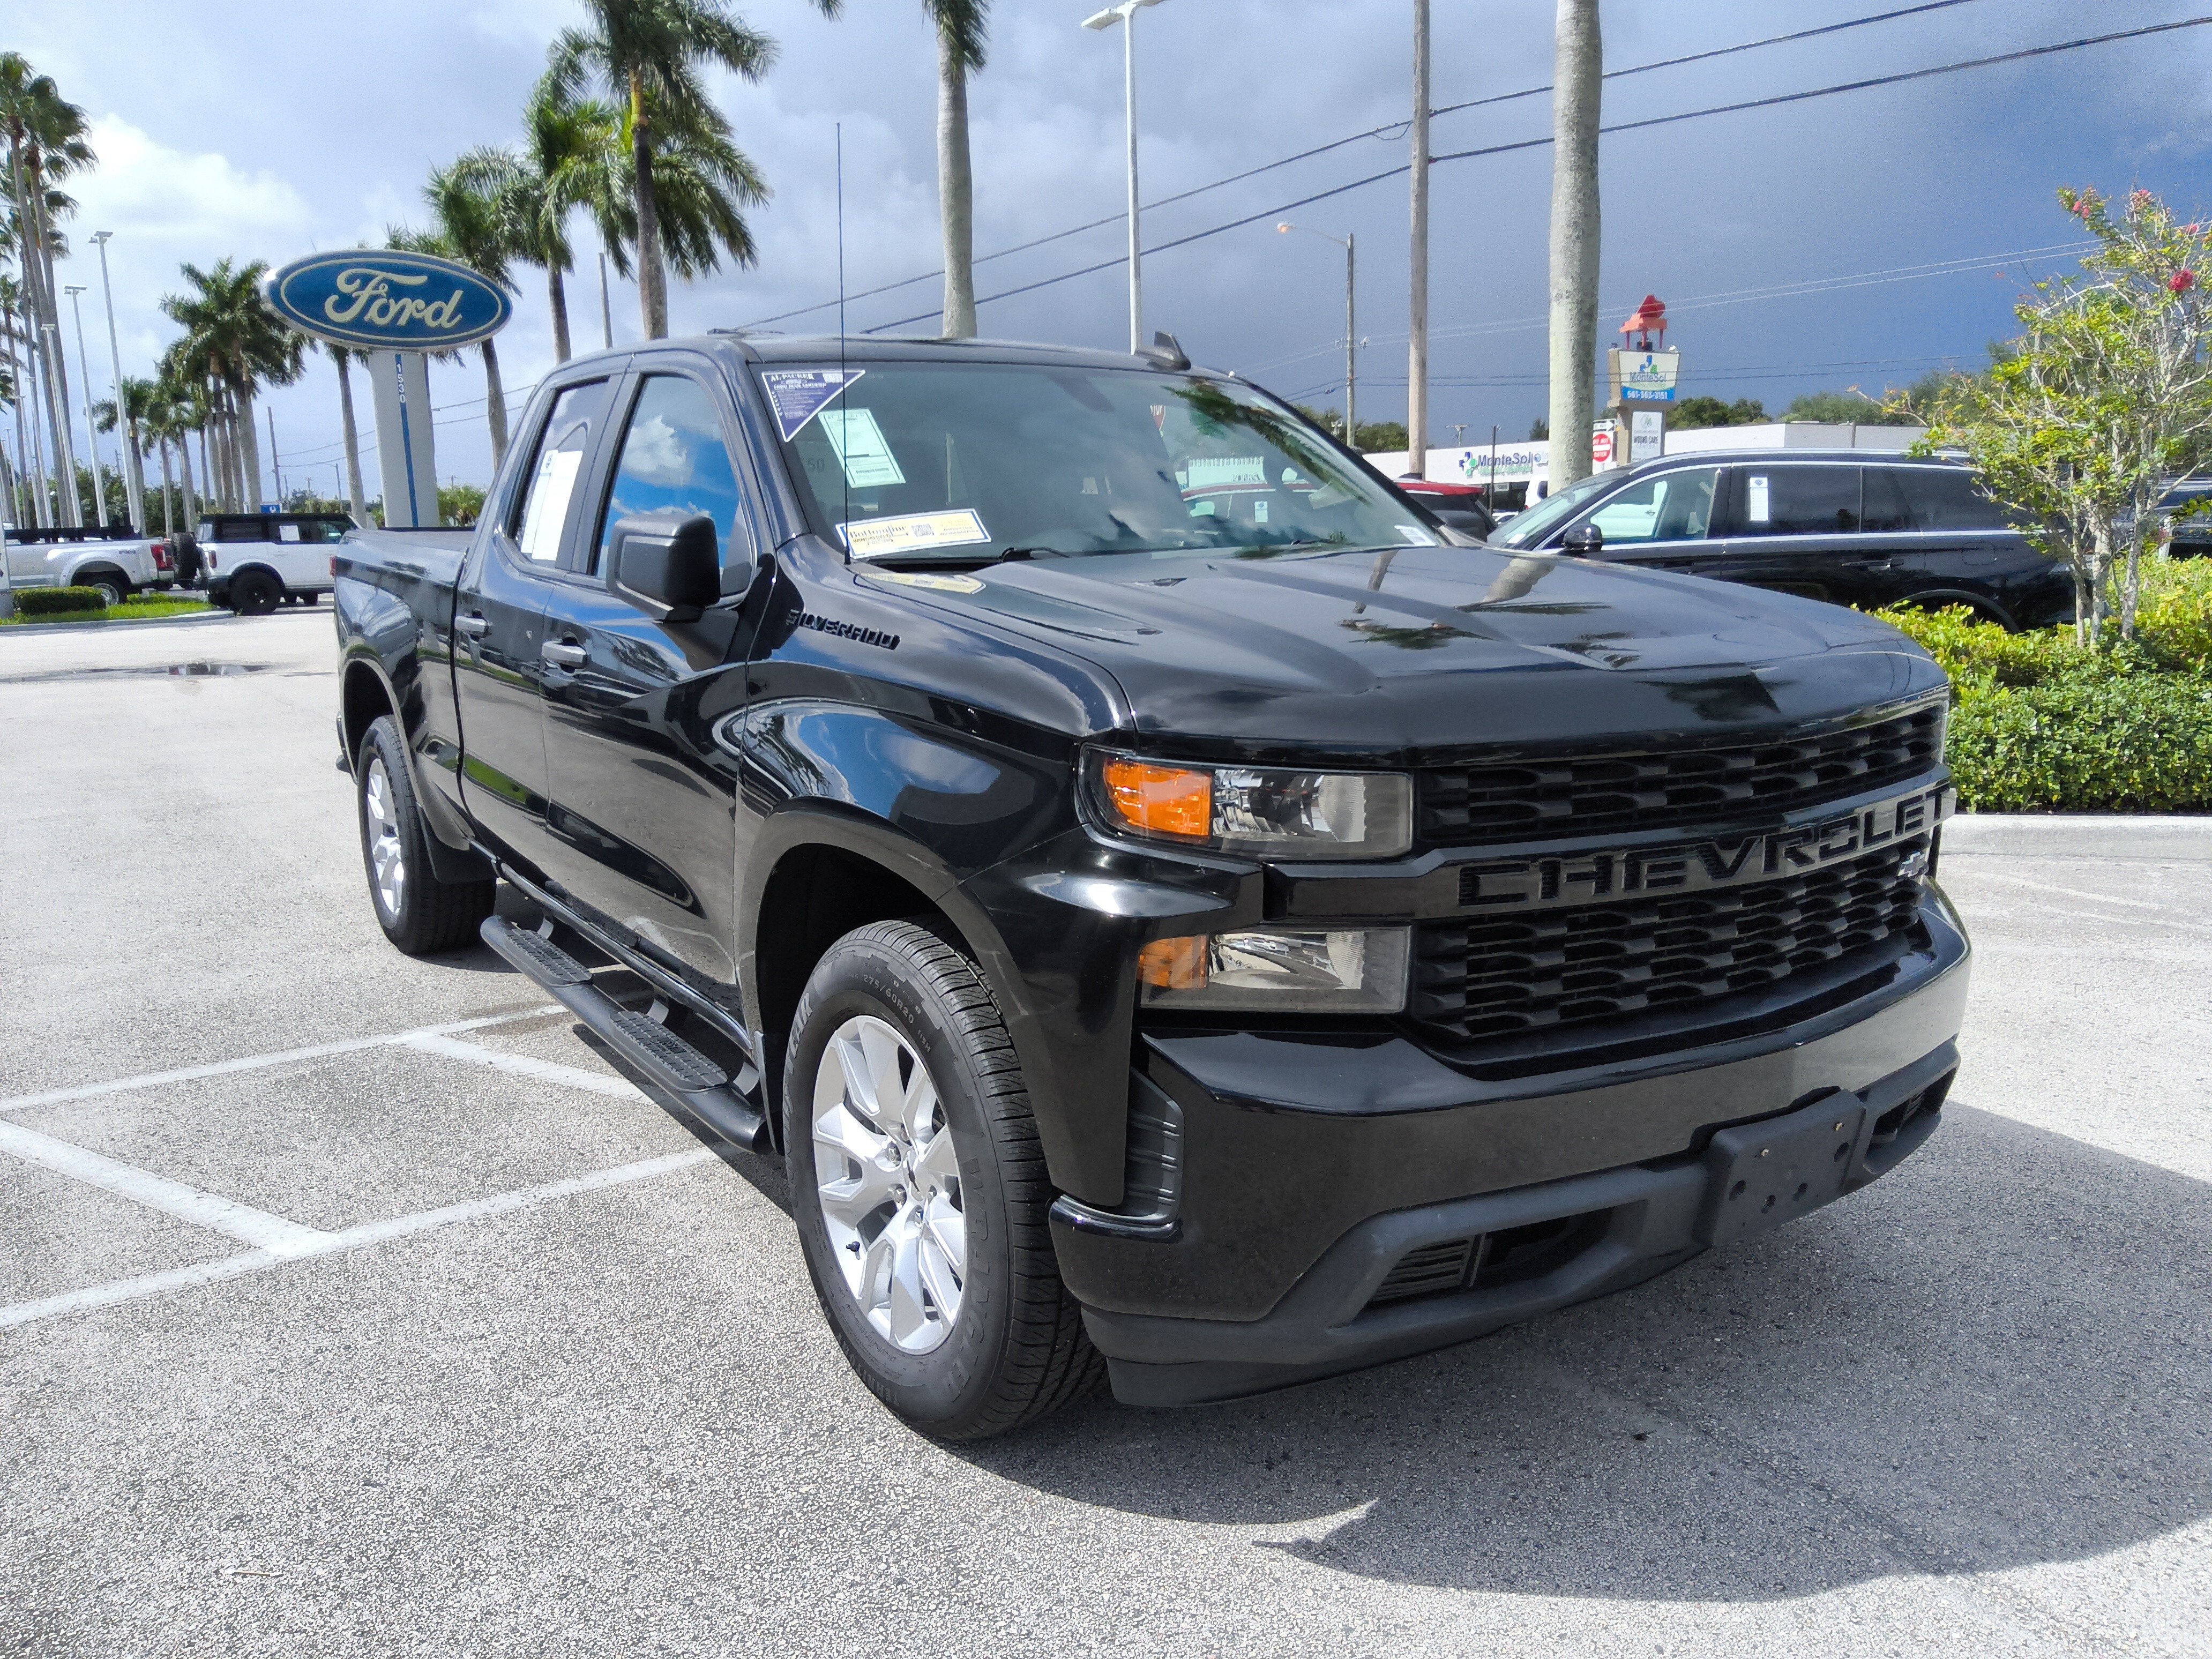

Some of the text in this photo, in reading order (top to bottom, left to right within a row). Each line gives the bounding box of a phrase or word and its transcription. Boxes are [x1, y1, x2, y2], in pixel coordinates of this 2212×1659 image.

[324, 268, 464, 328] Ford
[397, 363, 406, 403] 1530
[1478, 452, 1531, 467] MonteSol
[786, 609, 901, 650] SILVERADO
[1458, 782, 1951, 906] CHEVROLET
[863, 974, 914, 1023] 275/60R20
